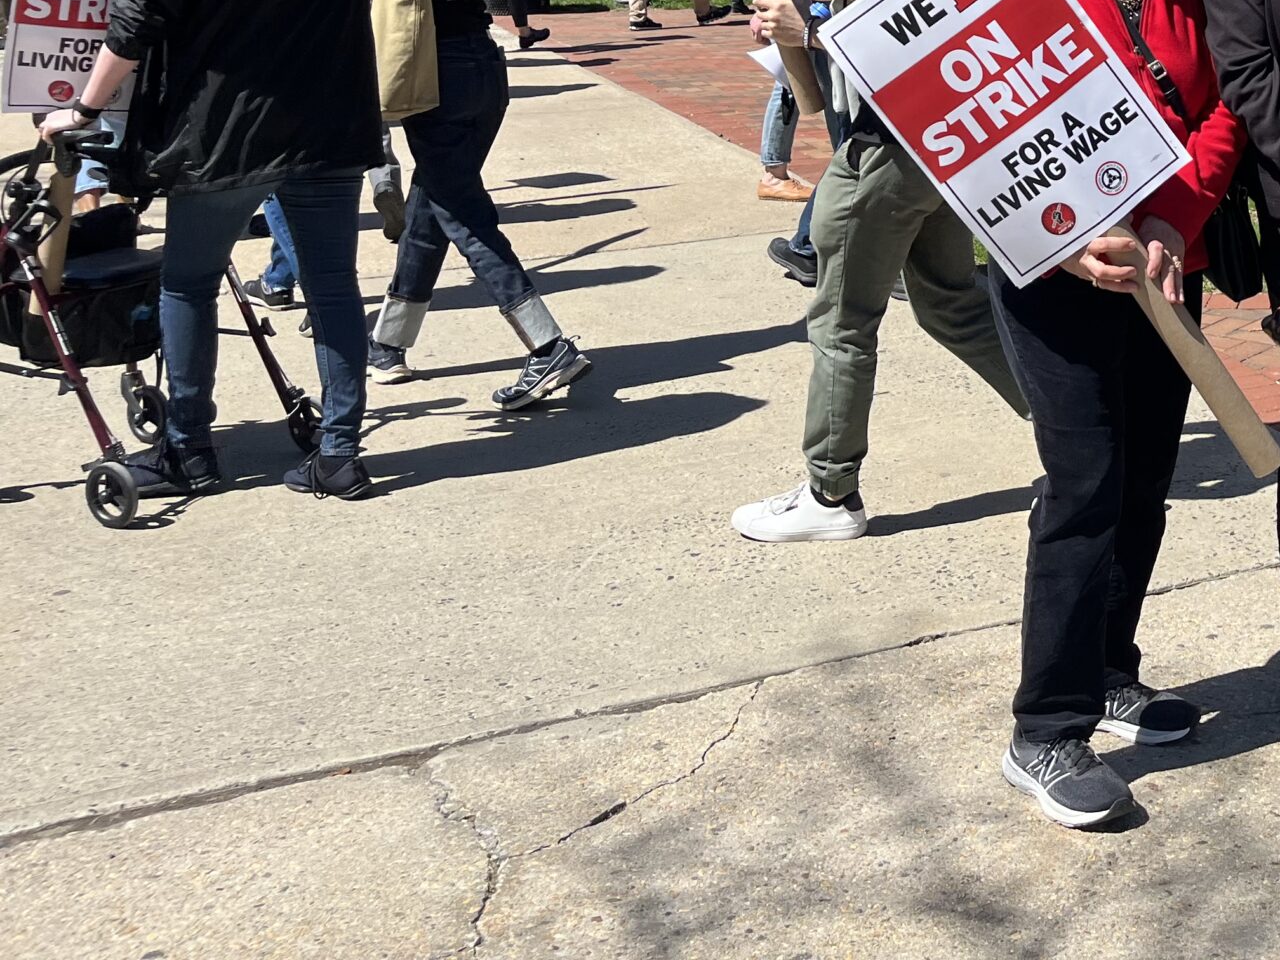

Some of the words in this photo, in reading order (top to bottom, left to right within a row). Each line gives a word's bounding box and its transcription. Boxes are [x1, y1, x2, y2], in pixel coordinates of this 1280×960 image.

[17, 51, 93, 72] LIVING
[940, 19, 1021, 93] ON
[922, 22, 1094, 167] STRIKE
[976, 156, 1067, 228] LIVING
[1062, 97, 1139, 165] WAGE
[1001, 128, 1062, 178] FOR
[1061, 111, 1085, 138] A
